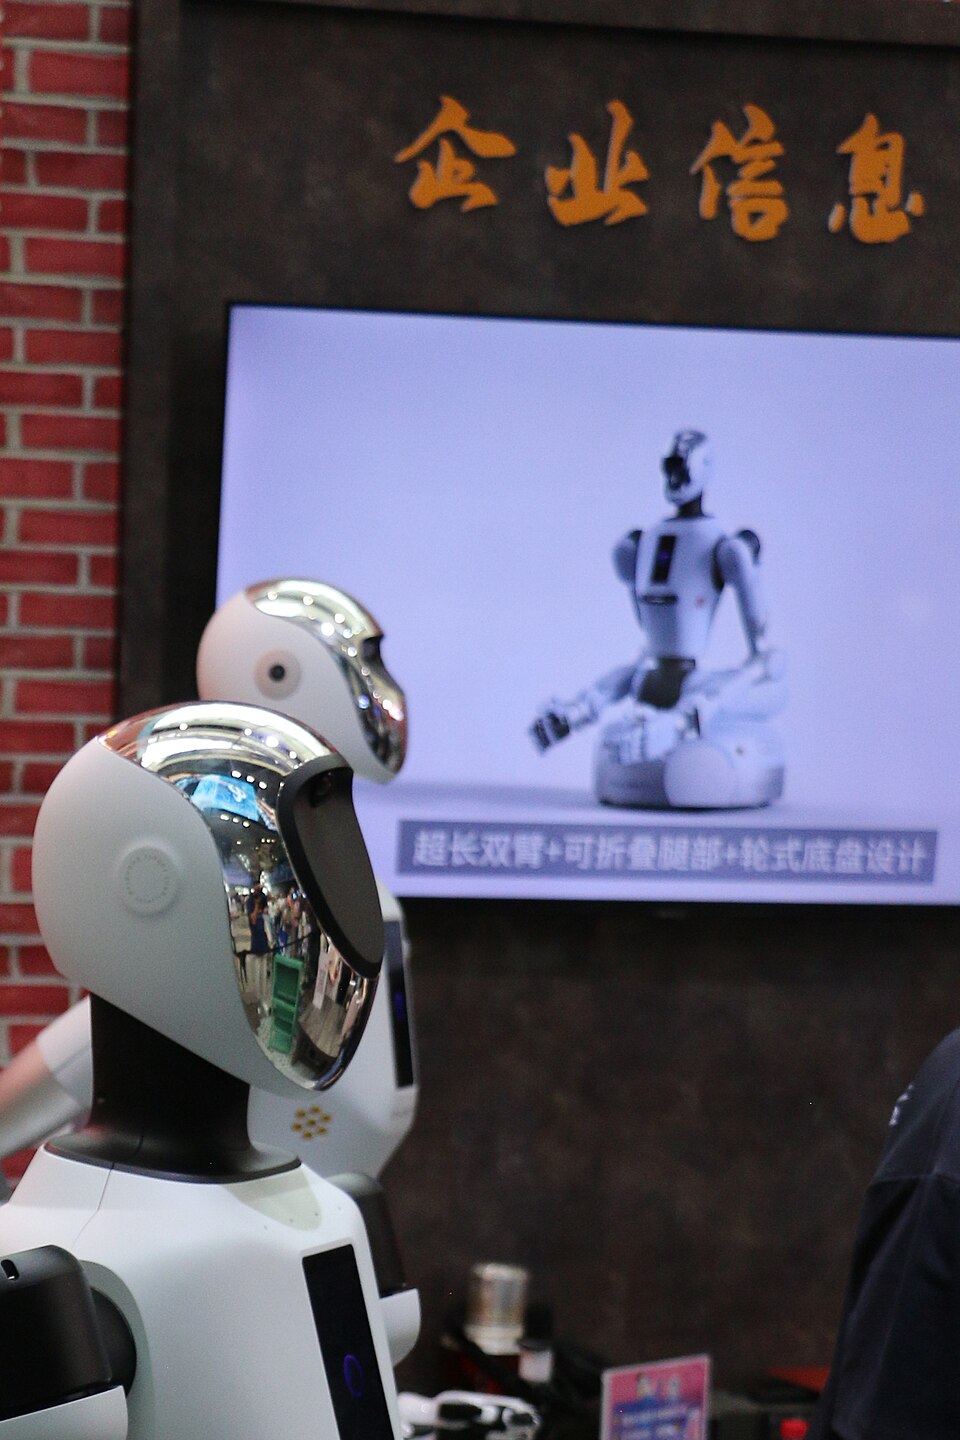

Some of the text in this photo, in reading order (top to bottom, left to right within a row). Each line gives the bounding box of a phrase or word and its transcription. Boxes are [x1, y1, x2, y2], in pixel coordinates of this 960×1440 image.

[394, 95, 926, 244] 企业信息
[413, 828, 928, 876] 超长双臂+可折叠腿部+轮式底盘设计
